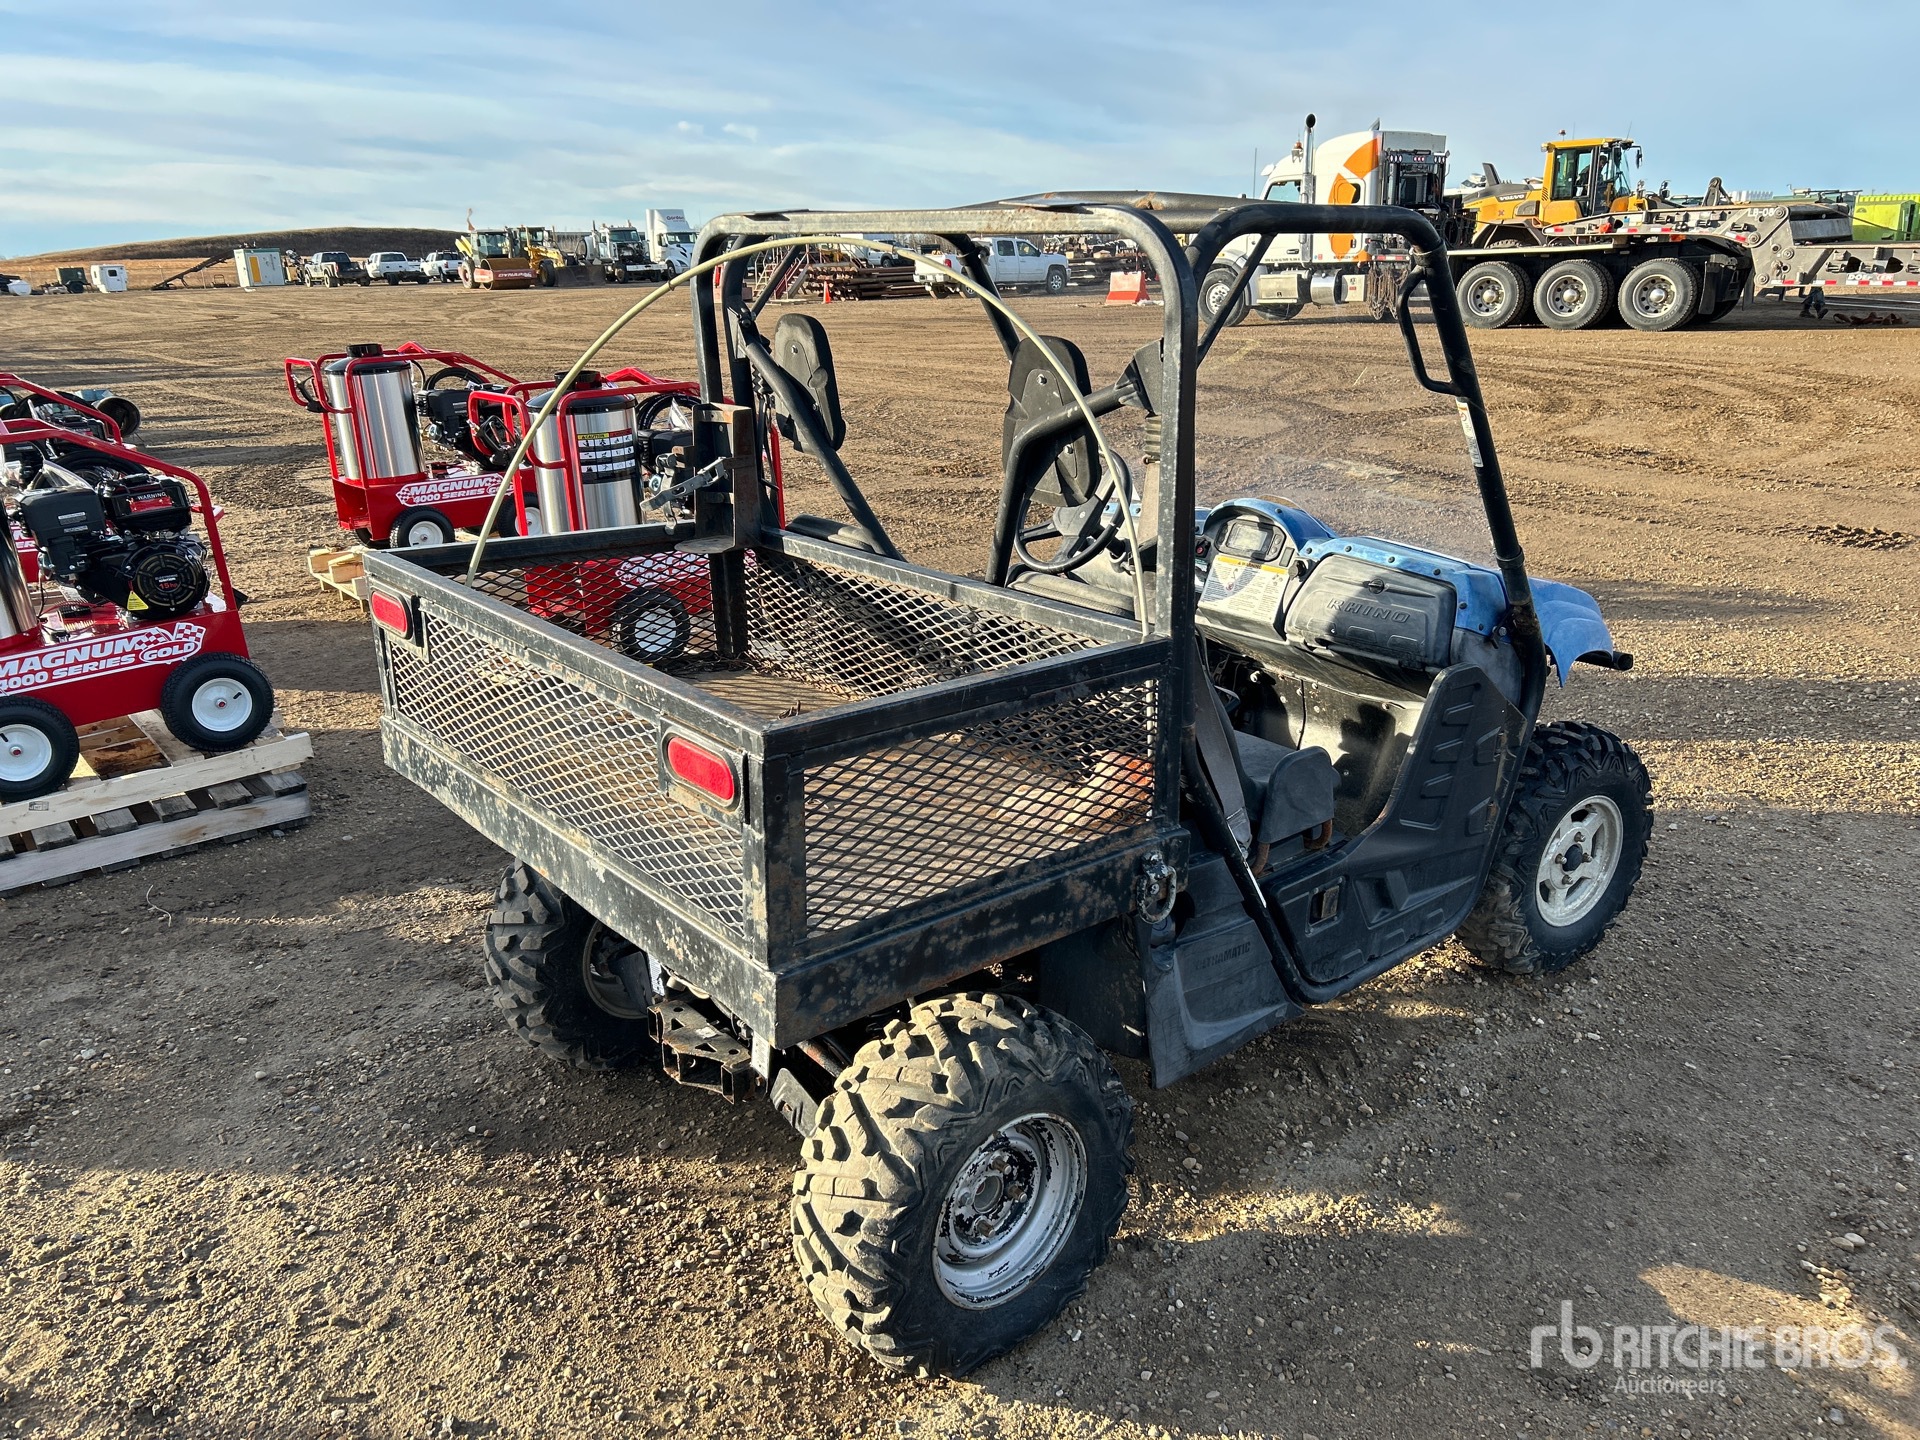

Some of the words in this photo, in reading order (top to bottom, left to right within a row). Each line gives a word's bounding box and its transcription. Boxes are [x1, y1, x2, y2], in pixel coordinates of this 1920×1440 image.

[137, 491, 166, 500] WARNING
[409, 477, 492, 496] MAGNUM
[414, 494, 440, 504] 4000
[442, 488, 485, 500] SERIES
[1326, 596, 1411, 624] RHINO
[0, 634, 142, 678] MAGNUM
[52, 653, 136, 680] SERIES
[143, 642, 192, 661] GOLD
